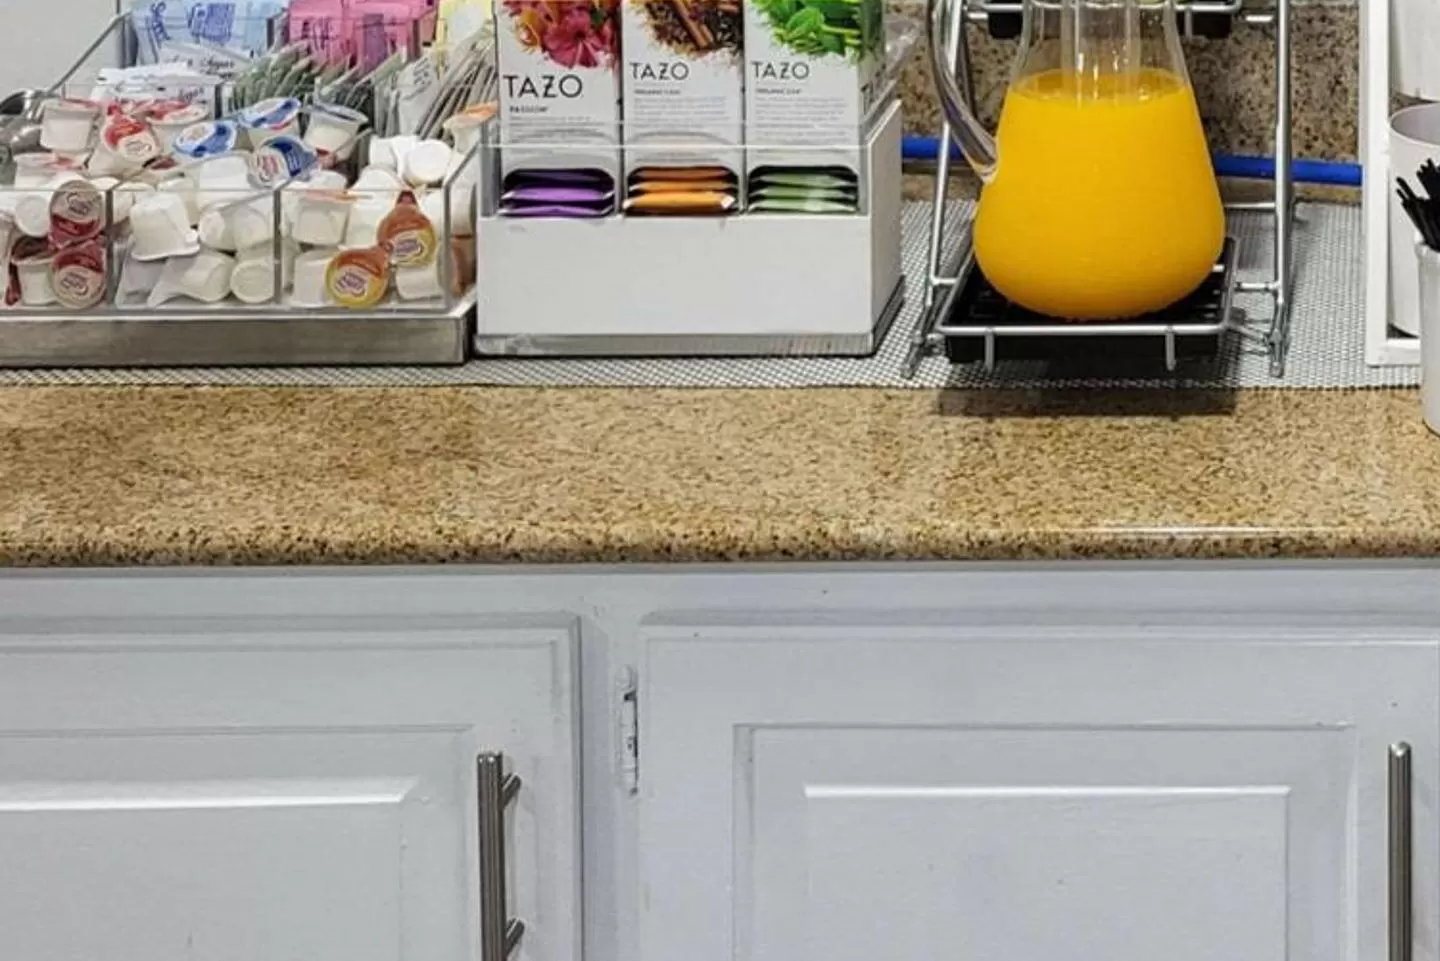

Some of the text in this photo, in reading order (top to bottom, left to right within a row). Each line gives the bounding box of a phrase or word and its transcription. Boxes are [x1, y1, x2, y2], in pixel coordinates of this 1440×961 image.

[629, 61, 690, 81] TAZO
[751, 61, 810, 80] TAZO
[503, 73, 583, 99] TAZO
